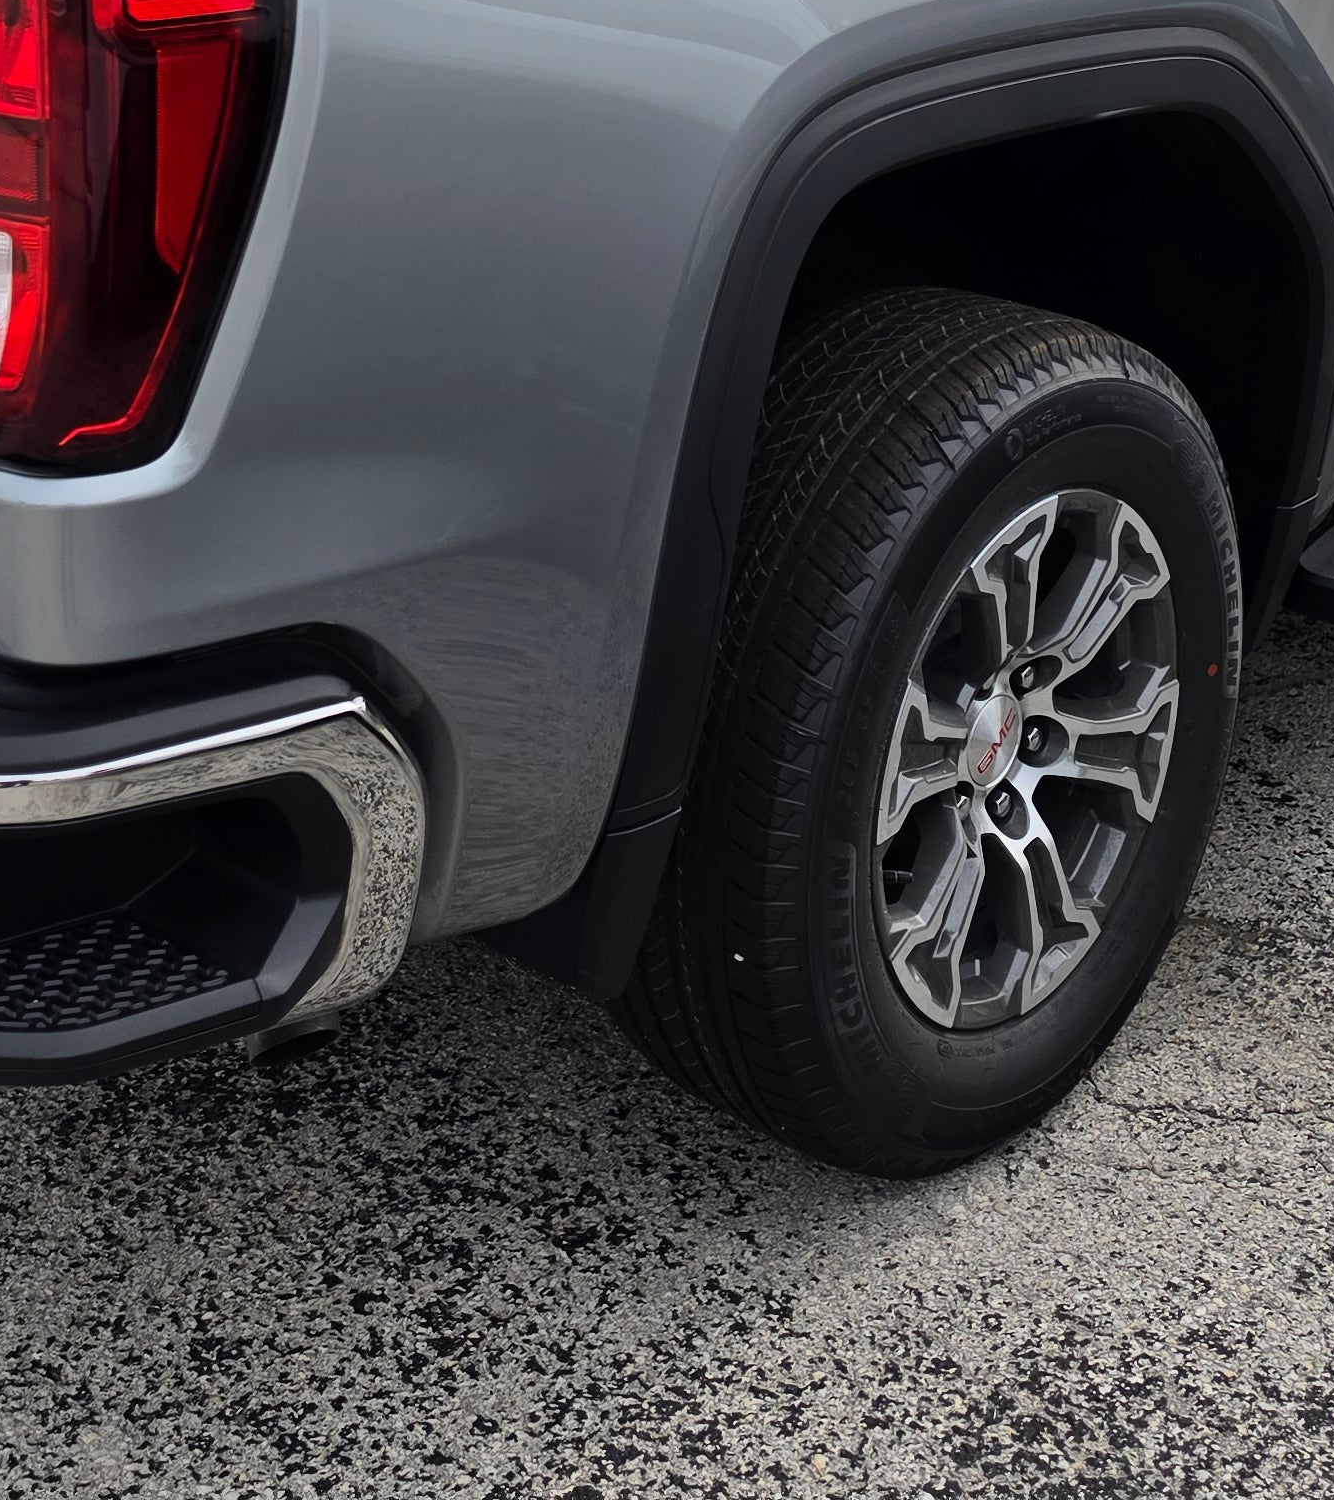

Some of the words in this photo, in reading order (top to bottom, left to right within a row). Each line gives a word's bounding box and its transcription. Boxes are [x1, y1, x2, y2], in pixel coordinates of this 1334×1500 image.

[1205, 488, 1240, 687] MICHELIN
[976, 707, 1016, 775] GMC
[827, 854, 883, 1063] MICHELIN
